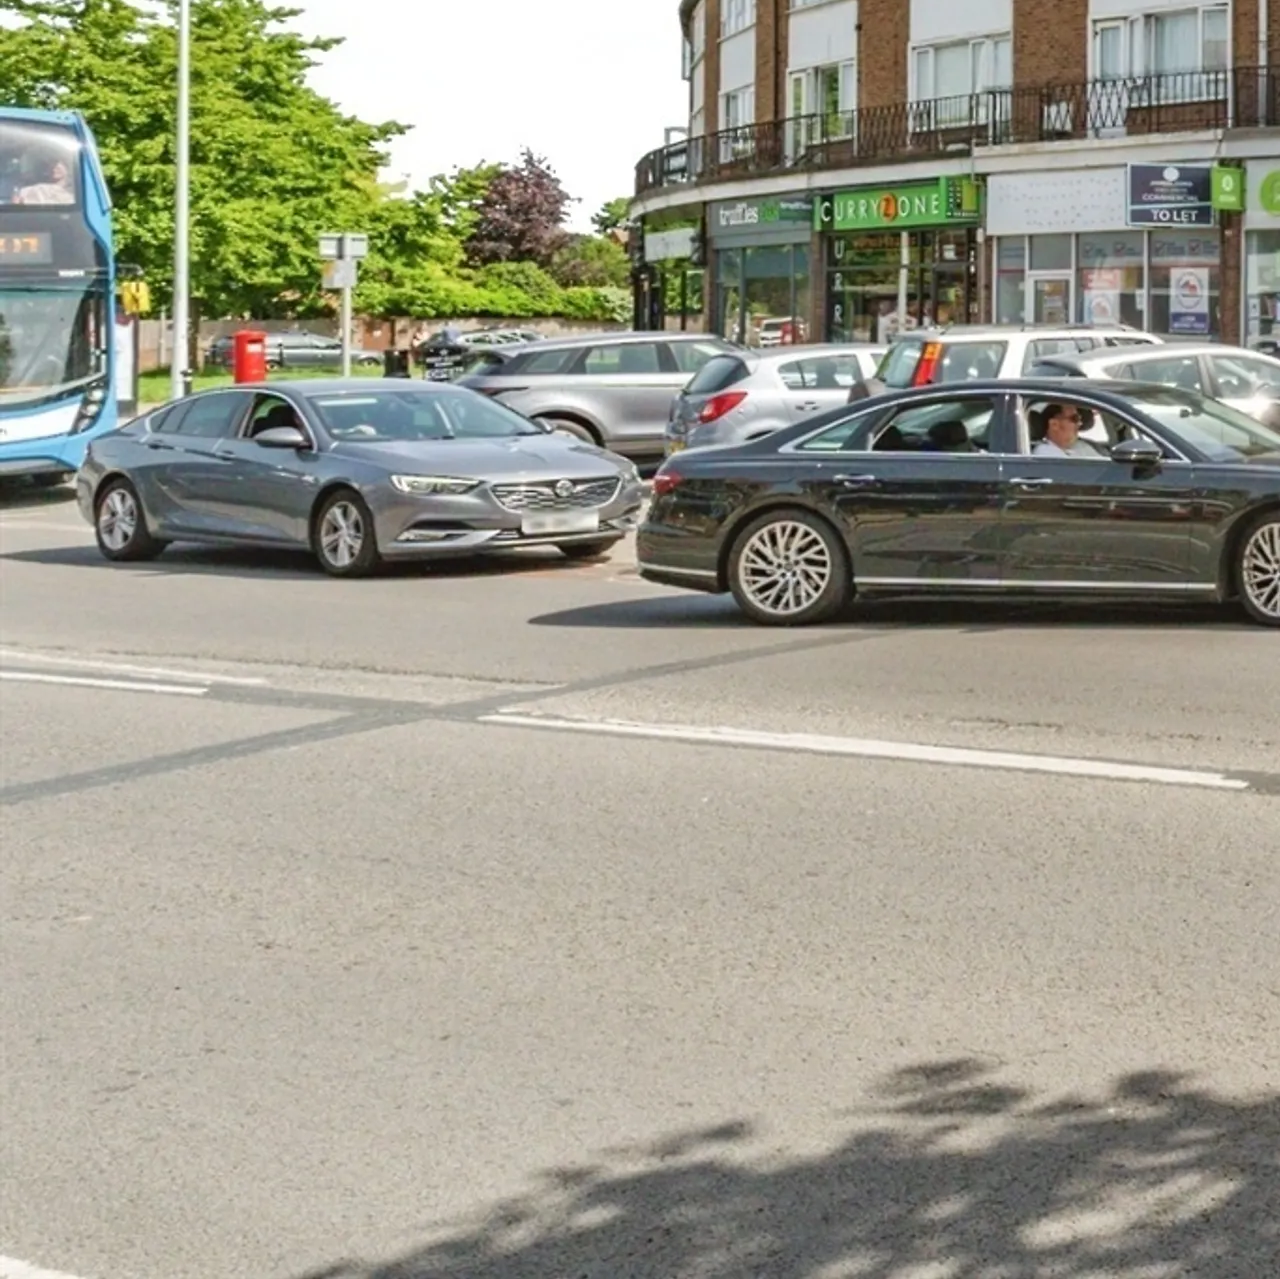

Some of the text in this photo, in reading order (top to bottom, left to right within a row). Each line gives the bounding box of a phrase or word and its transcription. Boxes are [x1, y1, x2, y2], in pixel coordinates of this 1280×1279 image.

[719, 203, 759, 226] truffles
[1151, 209, 1198, 221] TO LET
